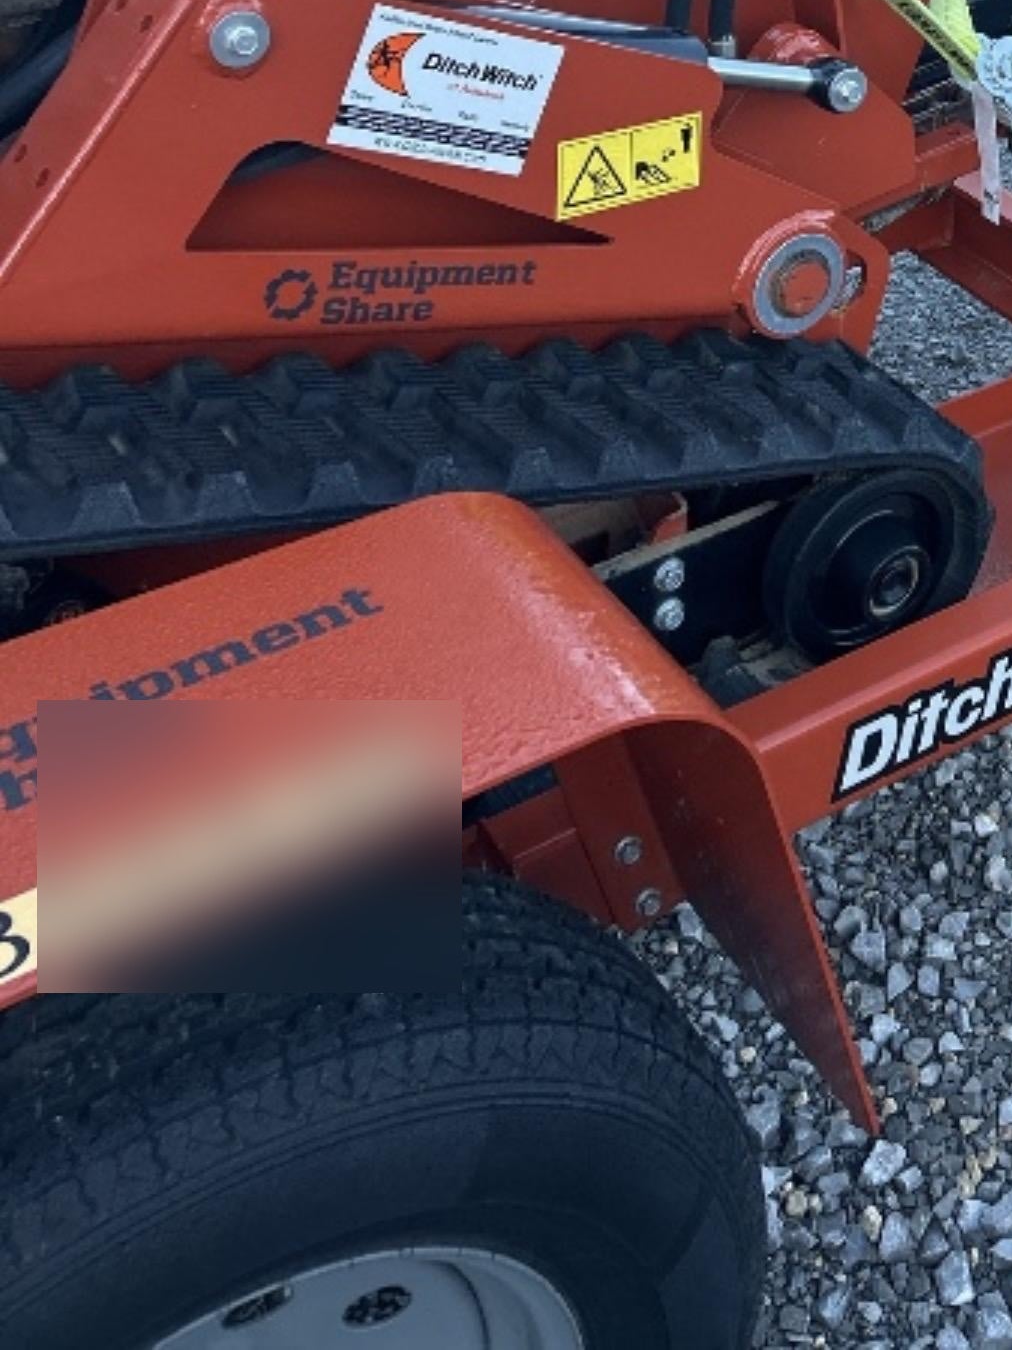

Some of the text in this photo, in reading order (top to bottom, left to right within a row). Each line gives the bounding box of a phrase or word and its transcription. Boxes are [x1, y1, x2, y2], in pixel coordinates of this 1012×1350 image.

[422, 52, 540, 91] Ditch Witch
[328, 259, 537, 294] Equipment
[320, 297, 435, 325] Share
